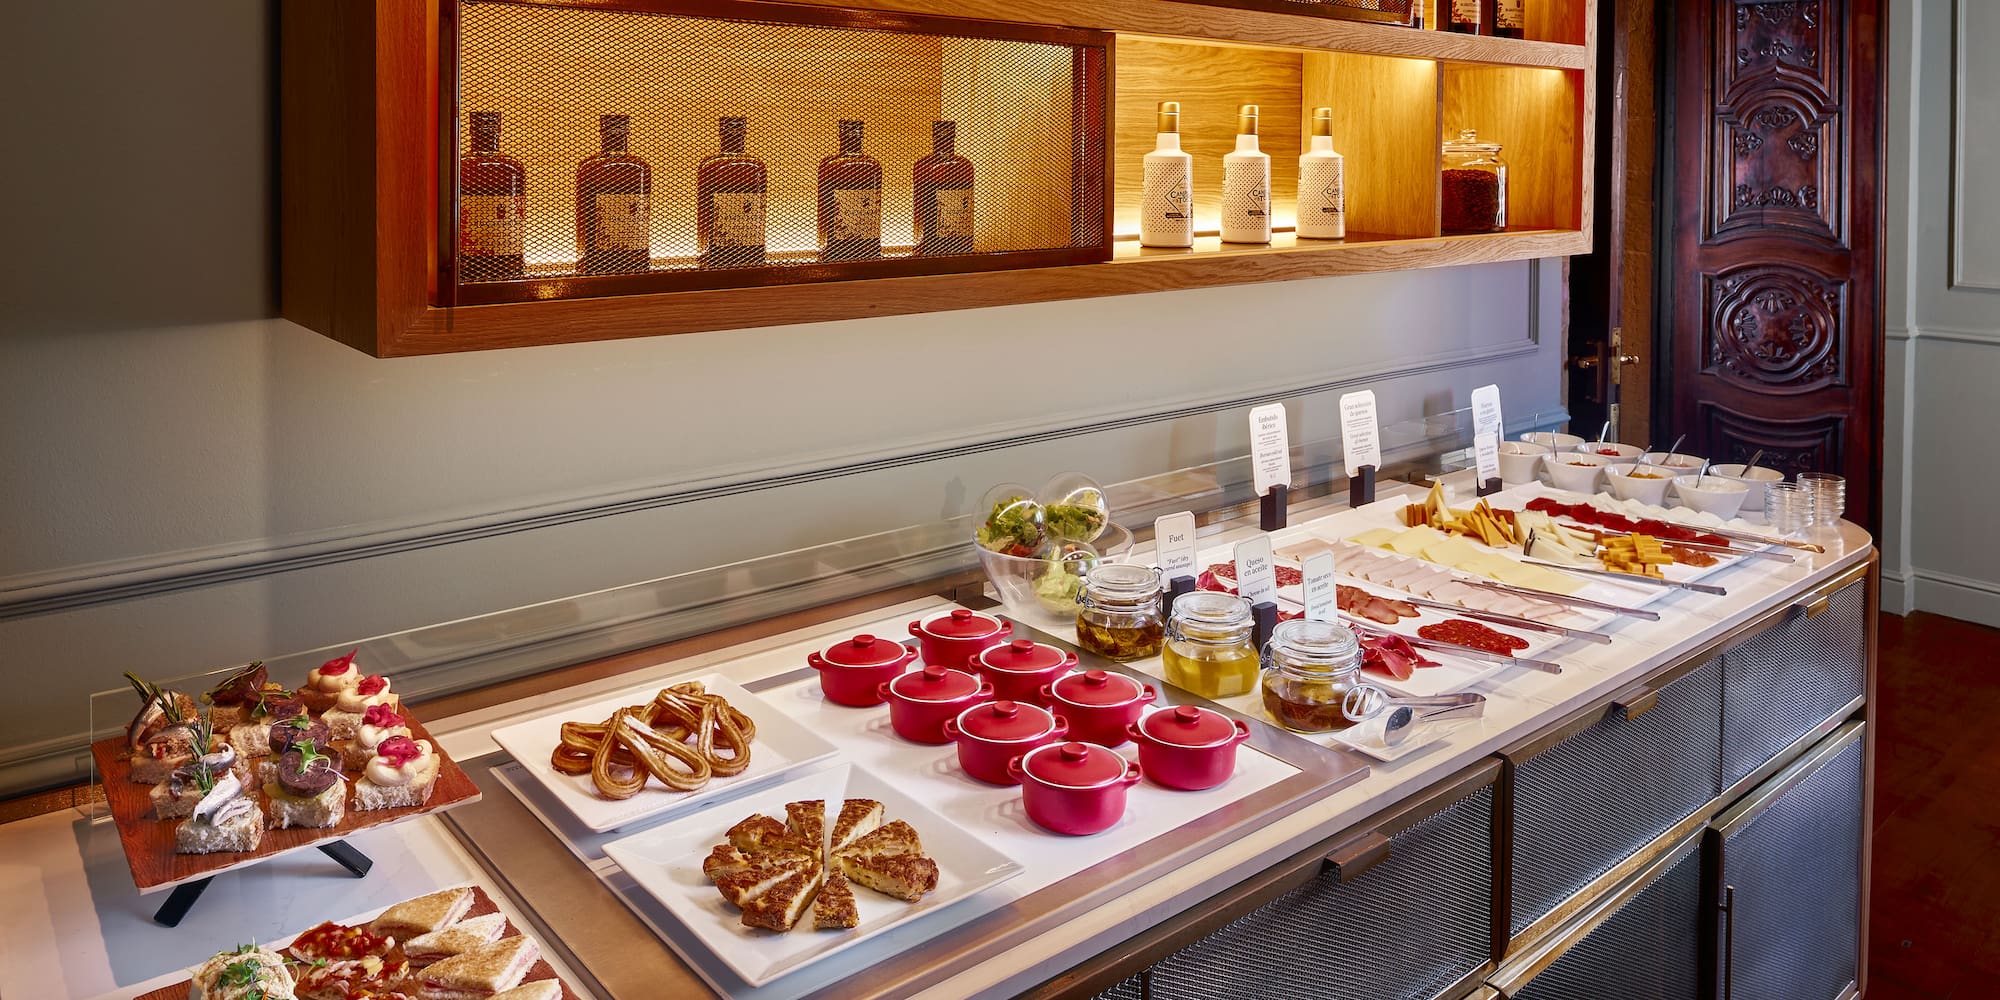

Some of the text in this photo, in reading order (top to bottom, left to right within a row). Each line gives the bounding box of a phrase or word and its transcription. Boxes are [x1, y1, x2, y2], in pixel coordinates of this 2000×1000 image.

[1169, 534, 1184, 543] Fuet
[1247, 557, 1264, 568] Queso
[1252, 564, 1268, 574] aceite
[1307, 575, 1322, 584] Tomate
